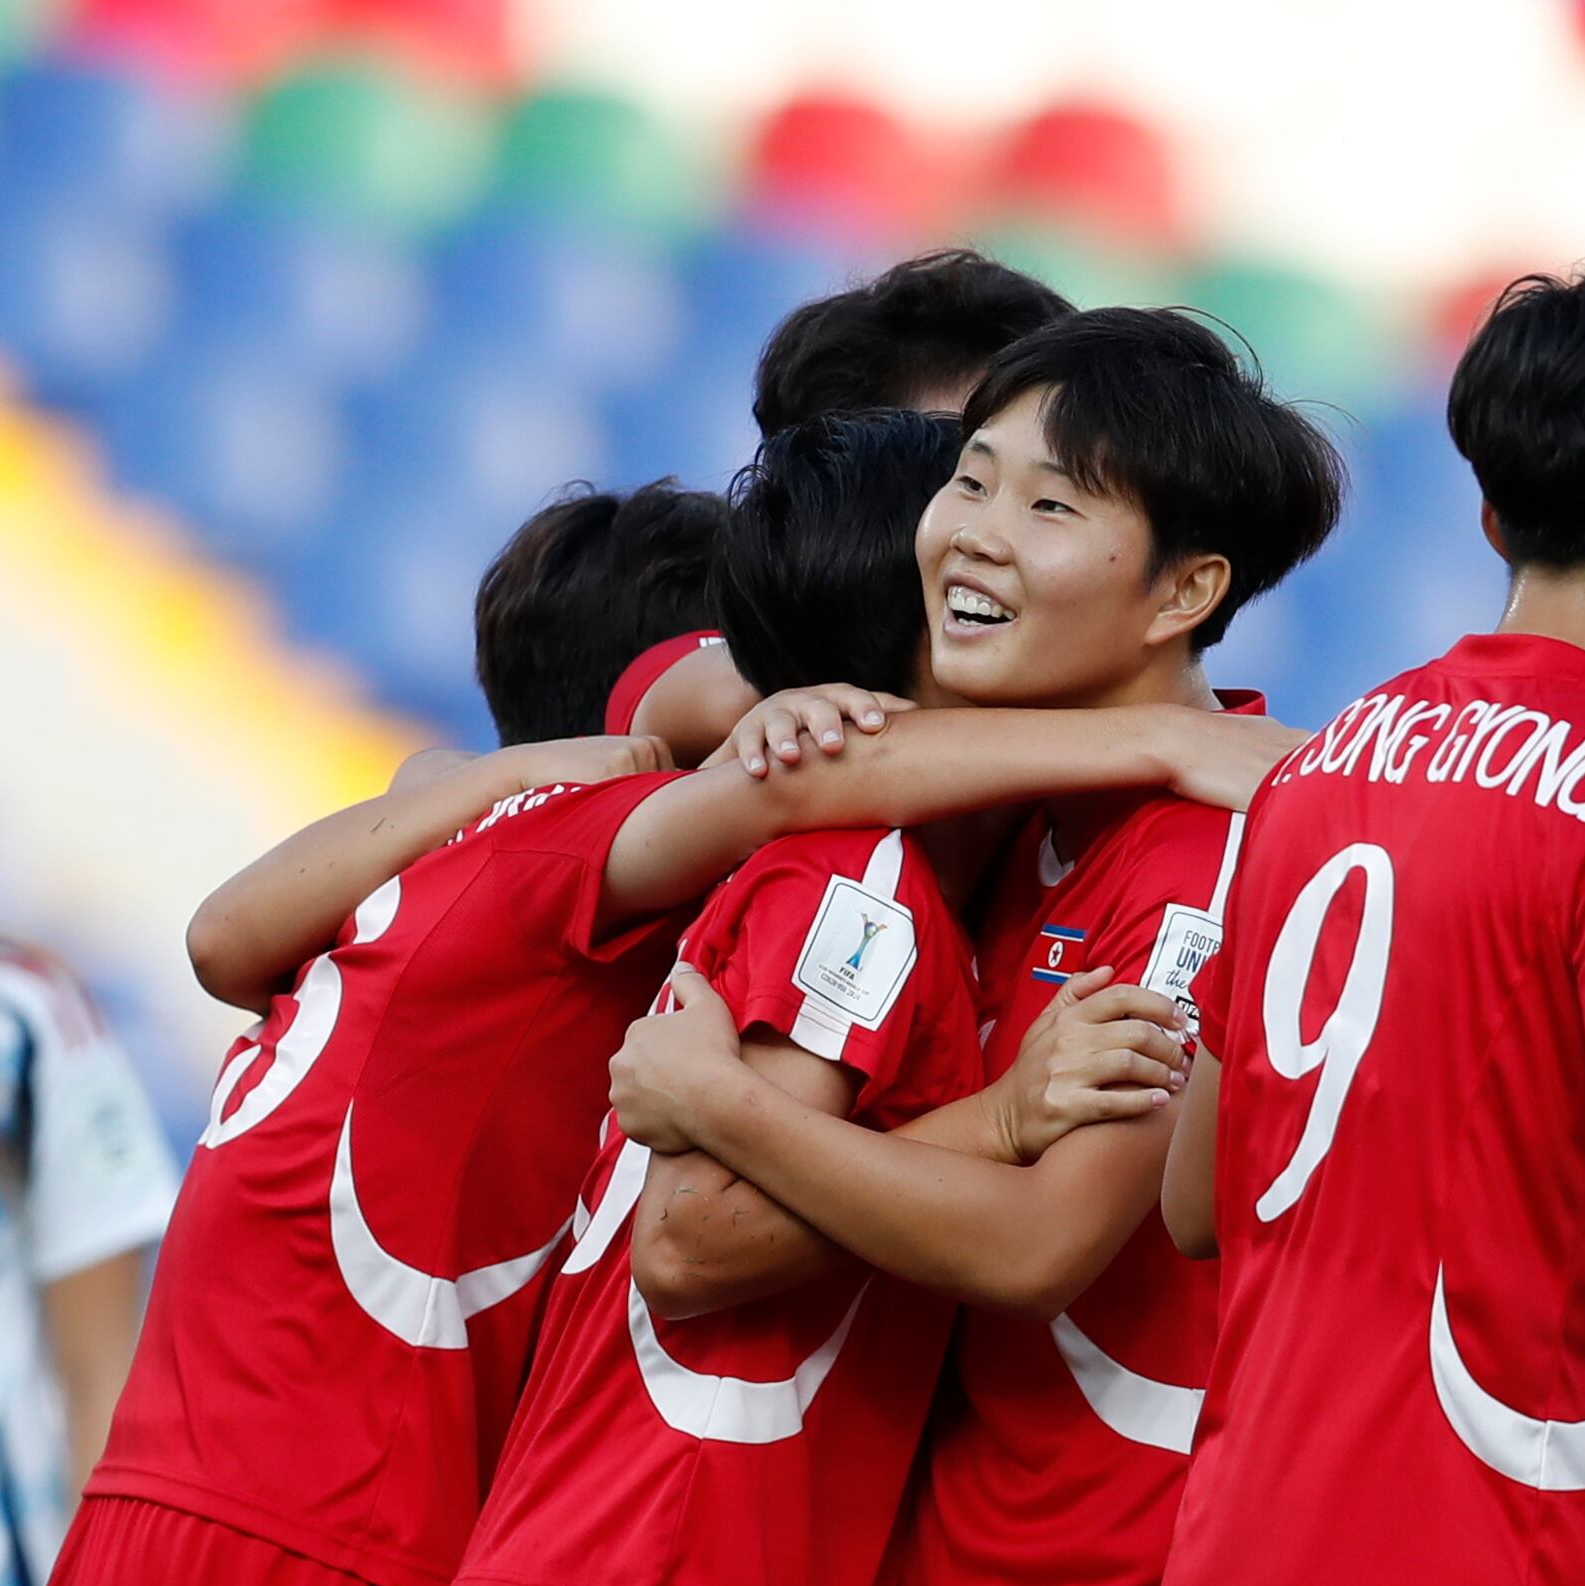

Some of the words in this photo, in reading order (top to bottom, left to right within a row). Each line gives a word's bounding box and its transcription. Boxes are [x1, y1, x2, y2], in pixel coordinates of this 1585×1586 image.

[1299, 693, 1452, 784] SONG
[1165, 969, 1188, 990] the
[1255, 842, 1395, 1223] 9
